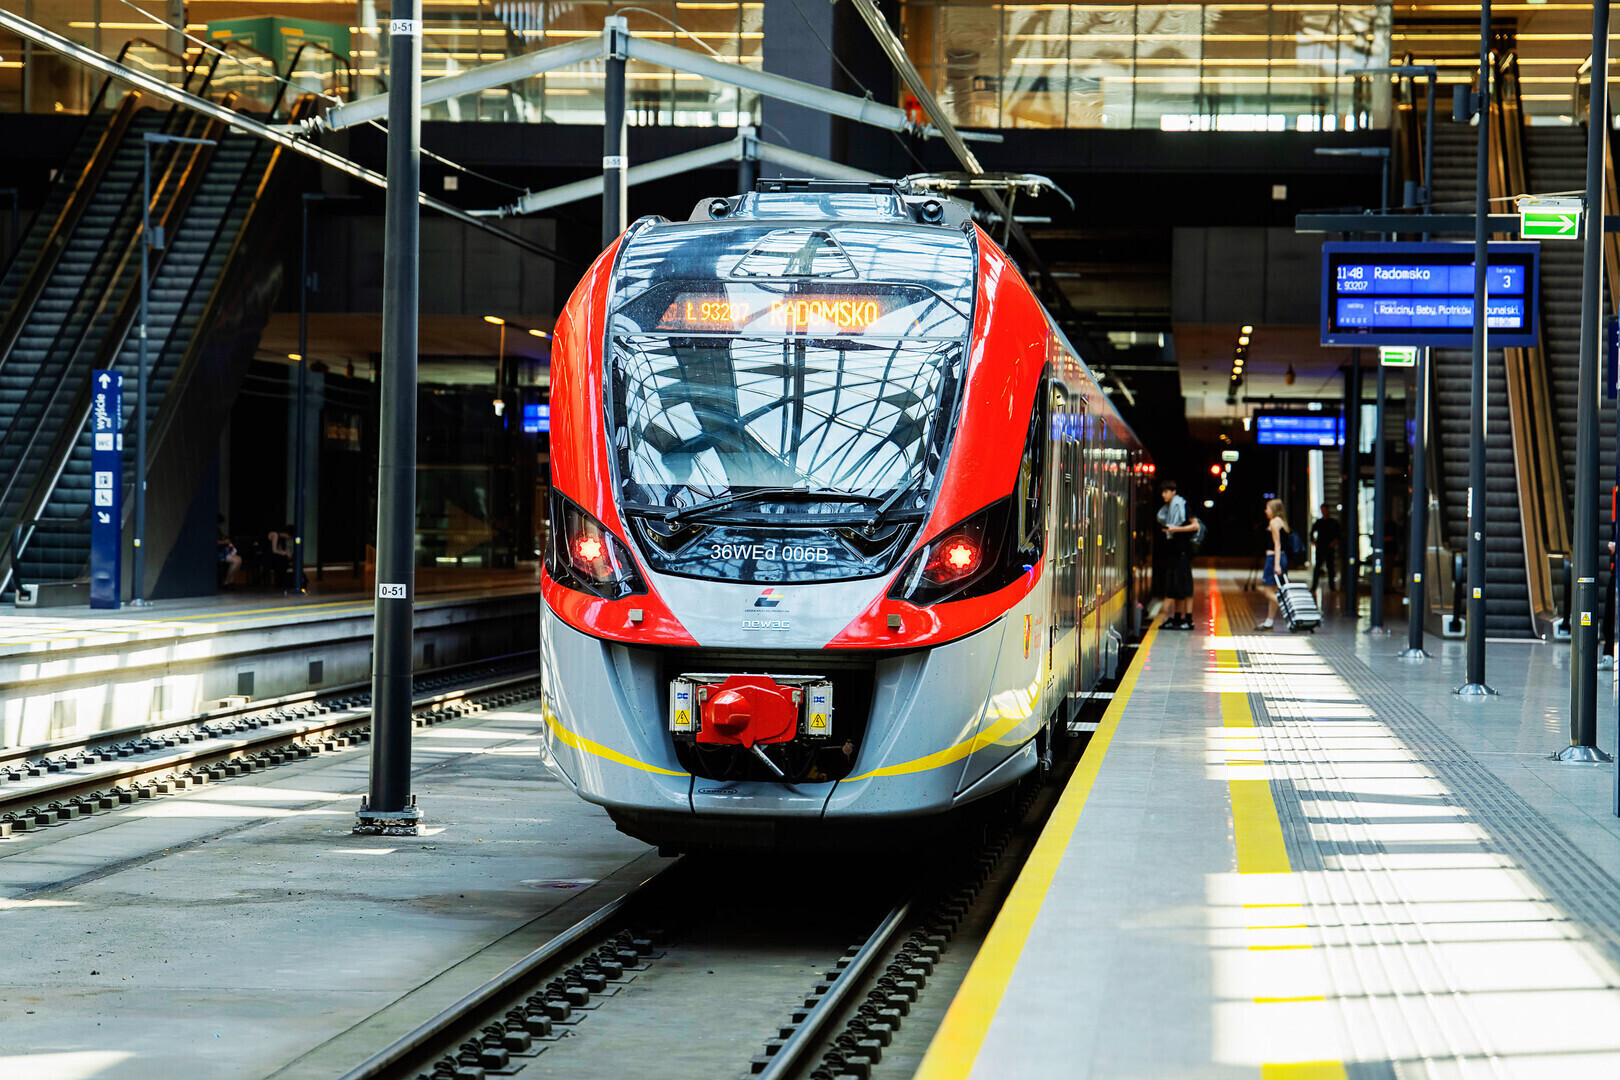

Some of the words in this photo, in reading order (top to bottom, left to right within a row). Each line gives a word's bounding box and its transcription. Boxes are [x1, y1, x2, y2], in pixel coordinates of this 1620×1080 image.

[392, 22, 413, 32] 0-51
[1374, 267, 1431, 280] Radomsko
[1344, 281, 1368, 291] 93207
[1502, 275, 1511, 288] 3
[686, 302, 697, 321] Ł
[701, 302, 749, 321] 93207
[771, 300, 878, 327] RADOMSKO
[1439, 304, 1471, 315] Piotrków
[710, 544, 776, 560] 36WEd
[782, 546, 829, 562] 006B
[382, 586, 403, 596] 0-51
